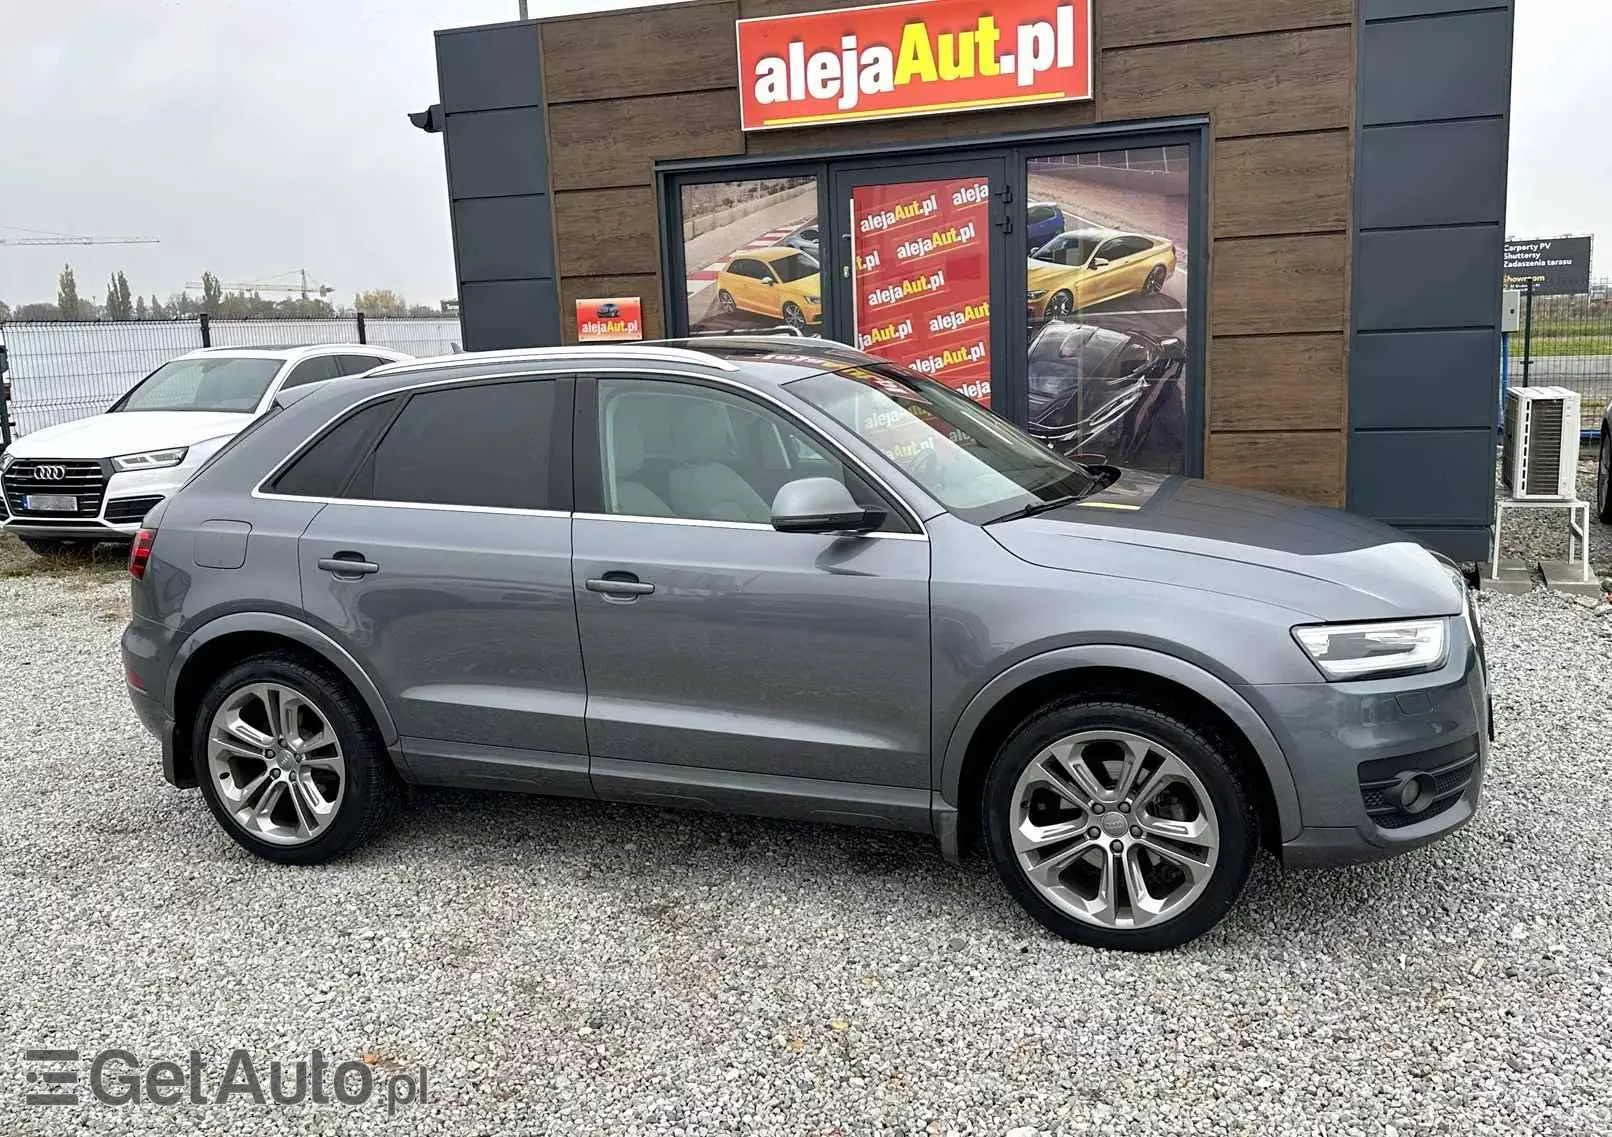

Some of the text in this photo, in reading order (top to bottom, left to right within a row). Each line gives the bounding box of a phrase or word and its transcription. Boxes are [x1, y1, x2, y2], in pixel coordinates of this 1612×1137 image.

[754, 5, 1074, 110] alejaAut.pl
[952, 184, 989, 206] aleja
[860, 194, 938, 232] alejaAut.pl
[896, 222, 976, 259] alejaAut.pl
[1539, 242, 1552, 250] PV
[1503, 259, 1546, 268] Zadaszenia
[867, 271, 945, 306] alejaAut.pl
[582, 320, 638, 335] alejaAut.pl
[928, 302, 990, 332] alejaAut
